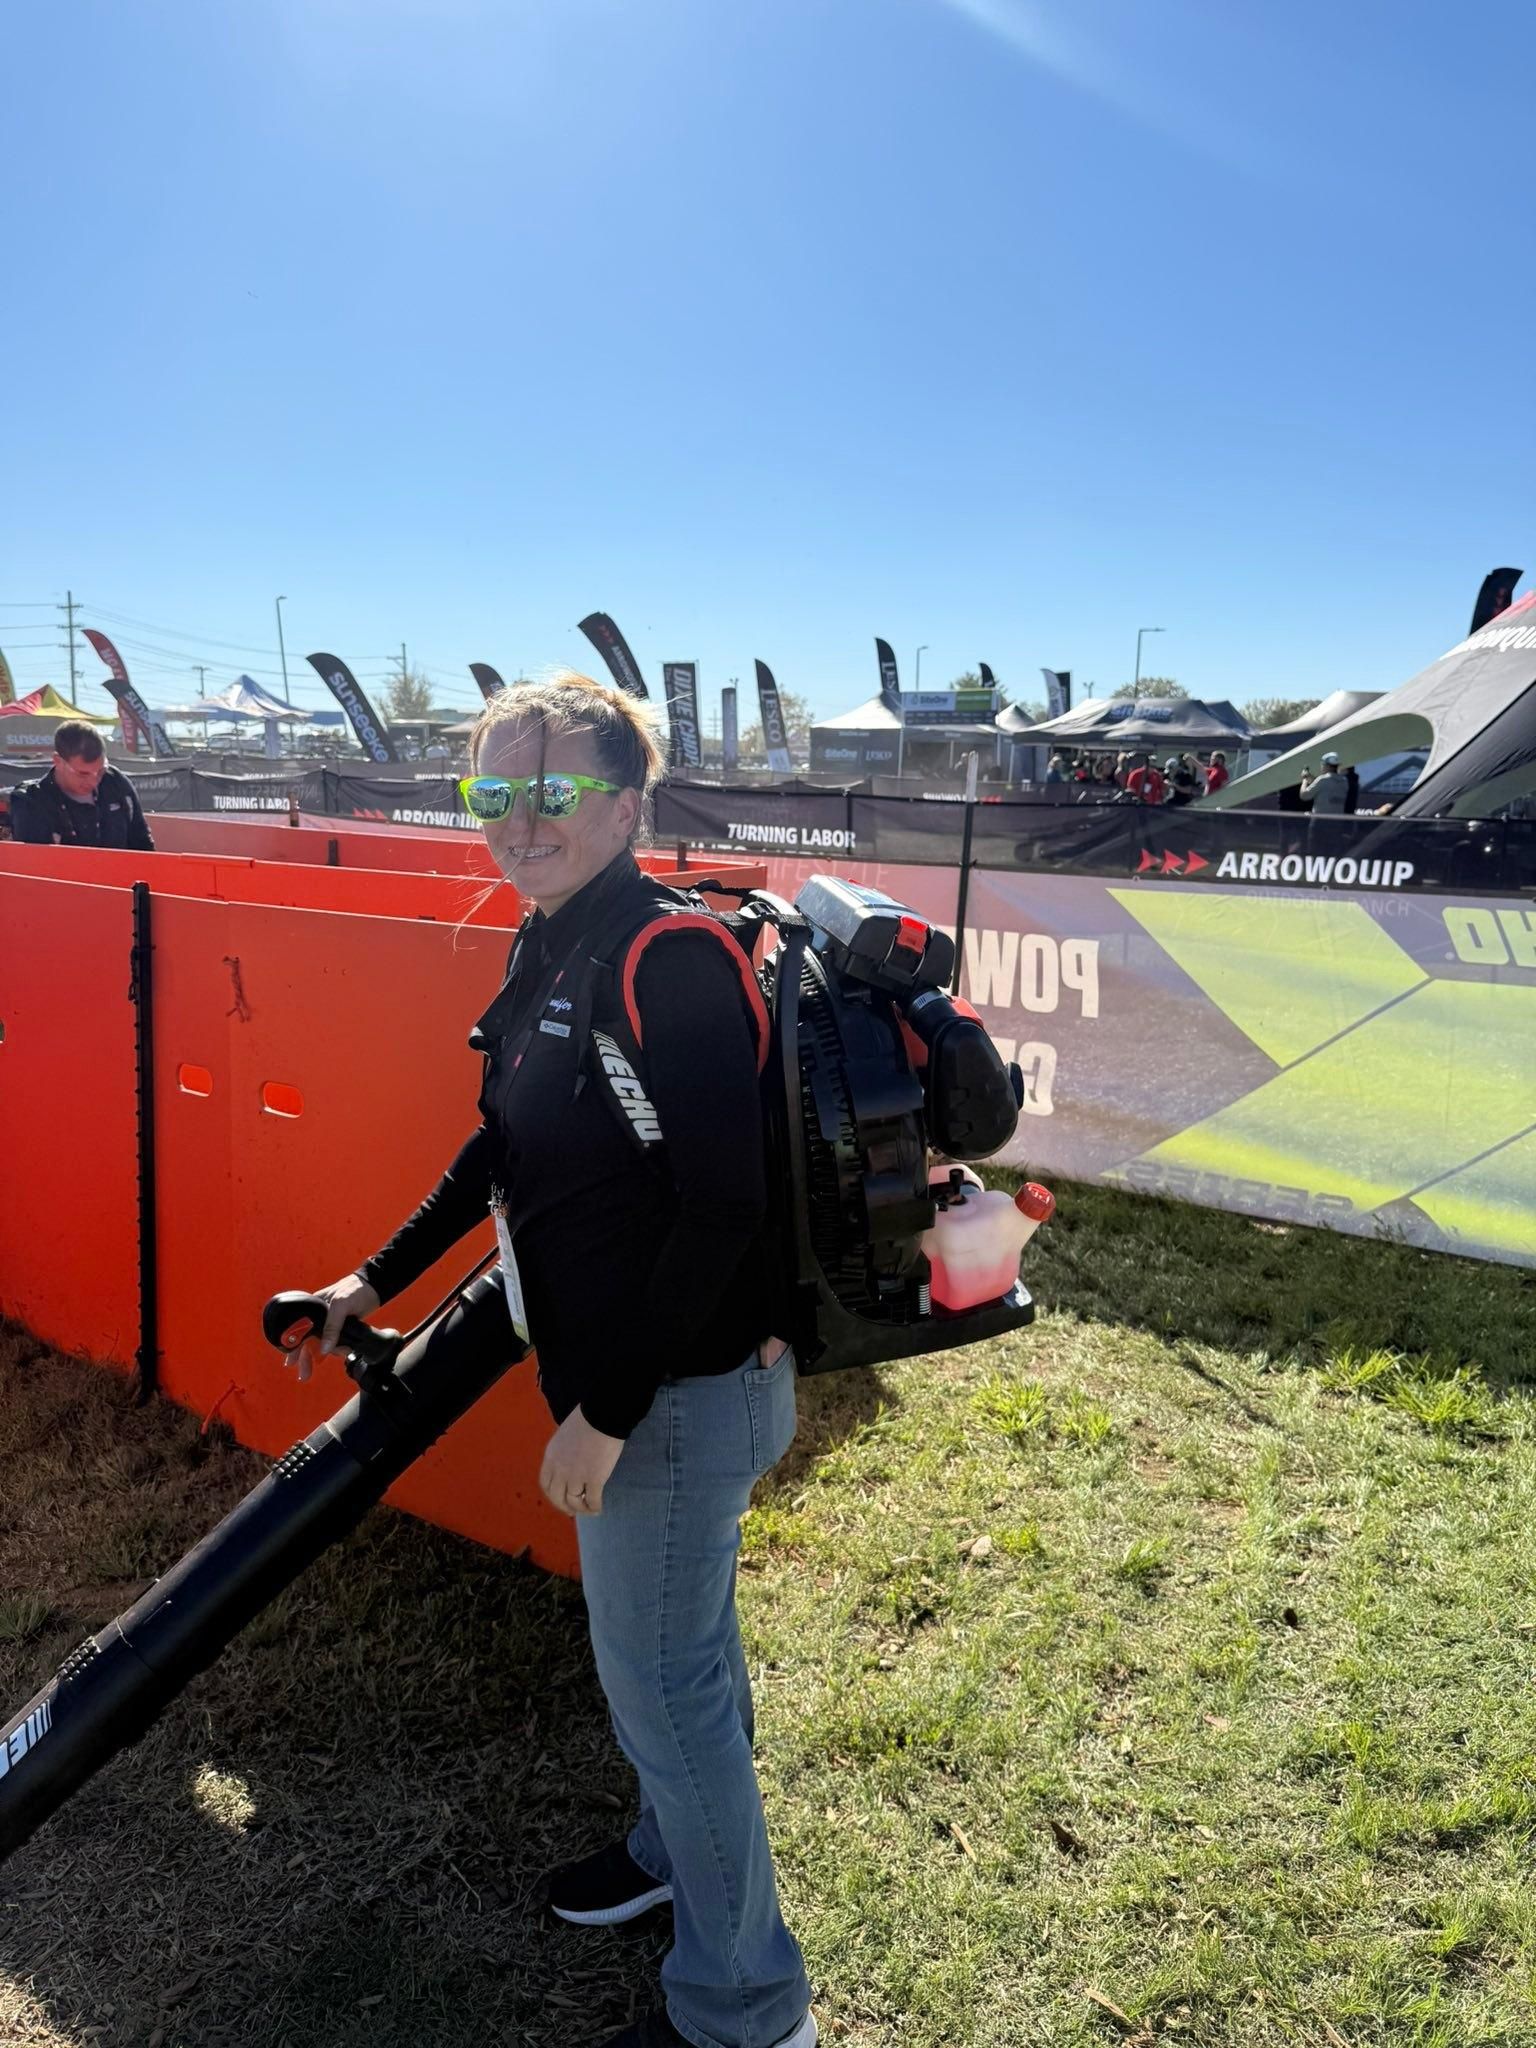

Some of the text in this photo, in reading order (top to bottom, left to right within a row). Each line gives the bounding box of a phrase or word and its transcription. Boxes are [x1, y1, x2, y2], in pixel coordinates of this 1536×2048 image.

[673, 667, 694, 718] DIXIE
[760, 688, 782, 743] LESCO
[213, 795, 259, 810] TURNING
[727, 823, 798, 845] TURNING
[801, 827, 857, 849] LABOR
